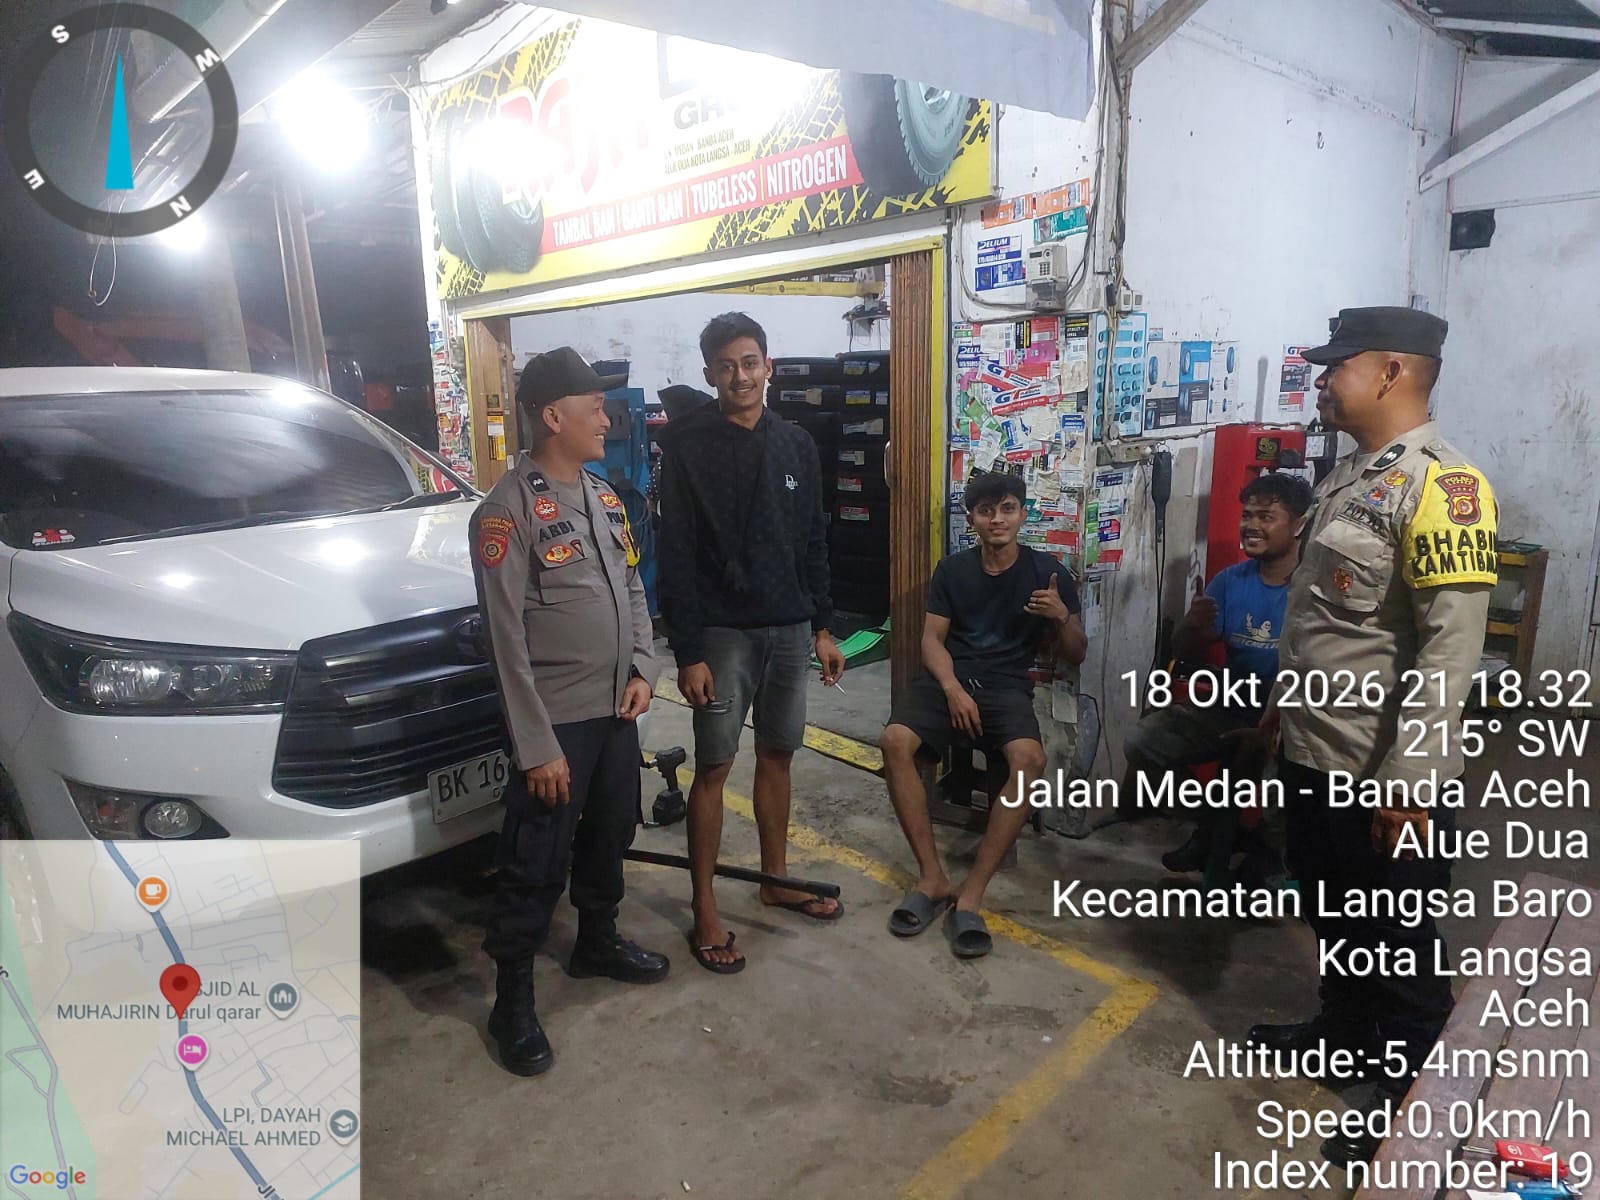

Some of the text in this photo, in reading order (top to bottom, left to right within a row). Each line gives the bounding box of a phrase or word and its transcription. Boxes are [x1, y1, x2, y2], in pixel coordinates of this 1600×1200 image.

[690, 151, 707, 167] KOTA
[706, 143, 730, 163] LANGSA
[733, 138, 751, 155] ACEH
[552, 213, 593, 247] TAMBAL
[593, 207, 615, 238] BAN
[657, 188, 684, 223] BAN
[690, 168, 757, 214] TUBELESS
[766, 144, 848, 198] NITROGEN
[978, 237, 1008, 250] DELIUM
[959, 346, 982, 354] DELIU
[437, 766, 470, 803] BK
